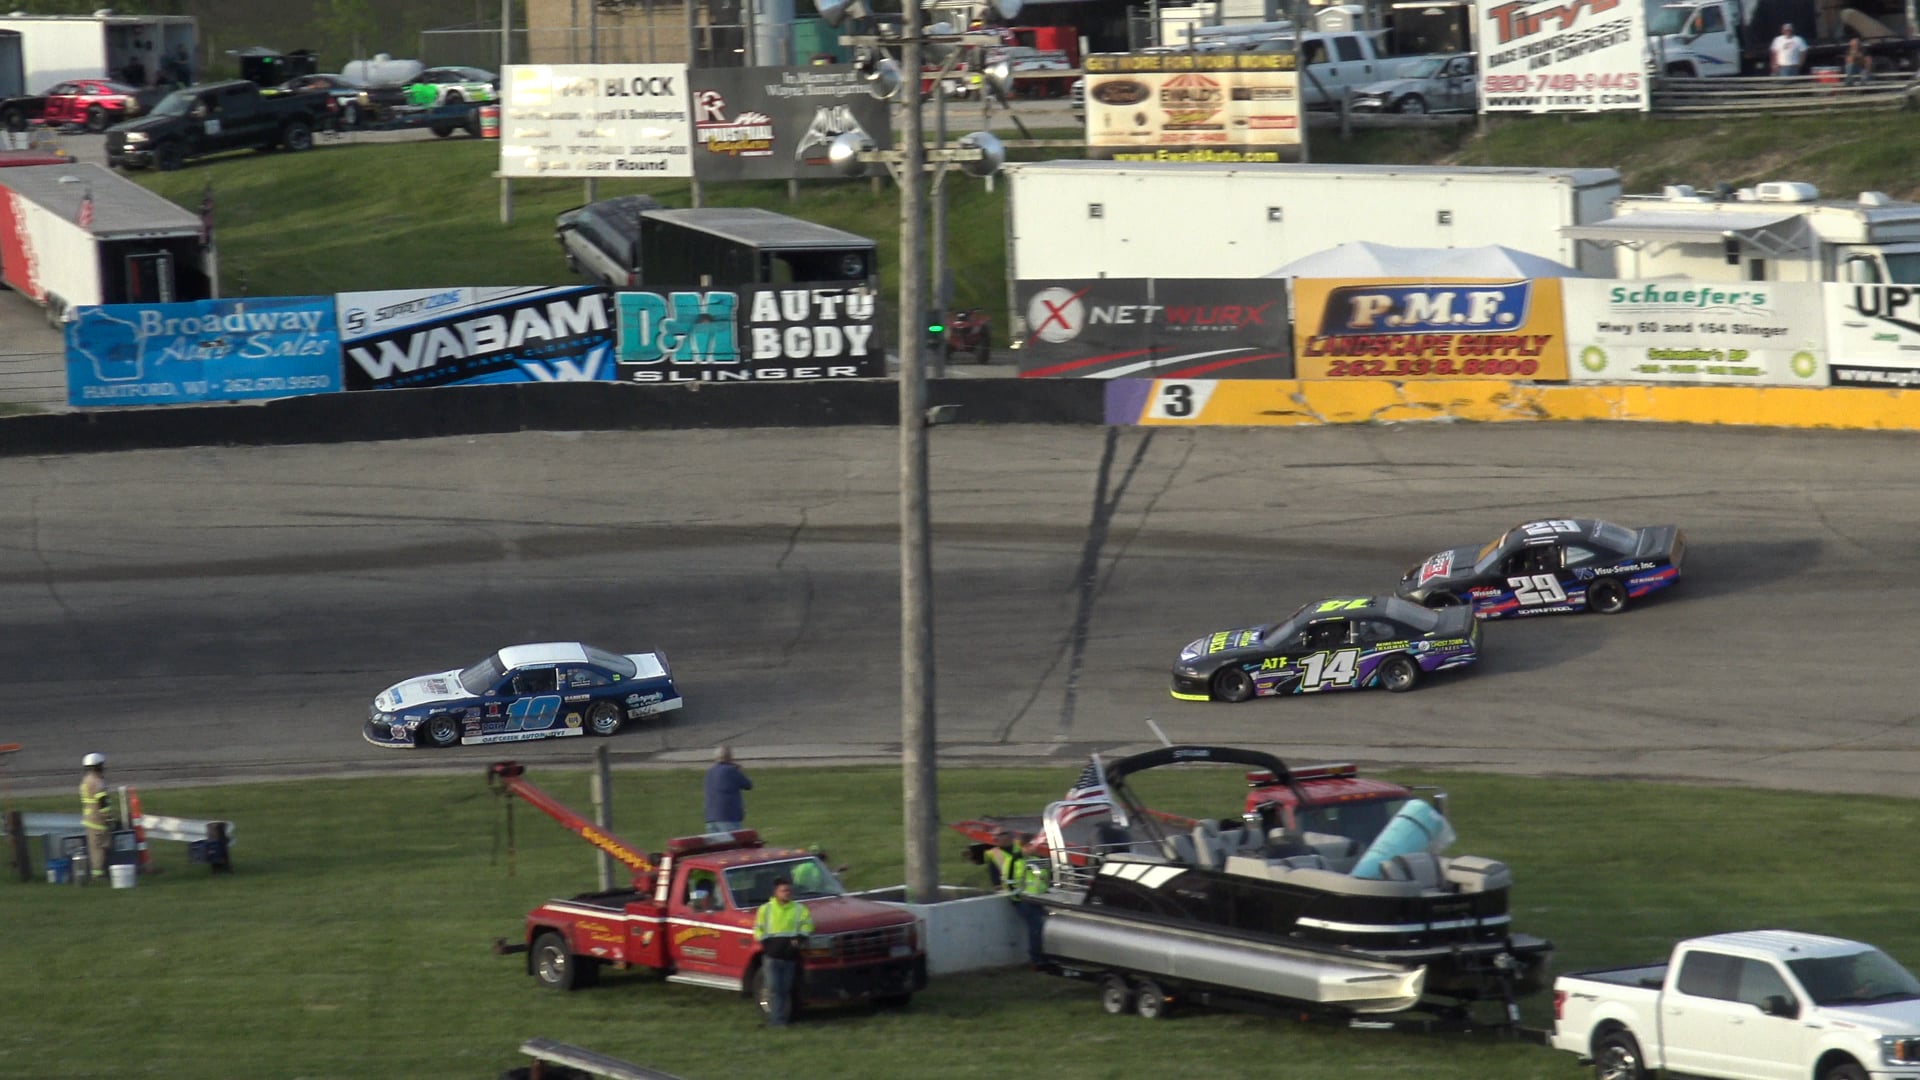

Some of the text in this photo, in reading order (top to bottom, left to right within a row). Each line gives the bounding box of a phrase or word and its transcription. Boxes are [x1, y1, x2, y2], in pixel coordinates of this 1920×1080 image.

[1556, 29, 1631, 62] COMPONENTS
[1086, 57, 1116, 70] GET
[1120, 56, 1160, 69] MORE
[1163, 56, 1193, 69] FOR
[1198, 55, 1235, 69] YOUR
[606, 76, 675, 97] BLOCK
[615, 158, 668, 171] Round
[751, 288, 875, 321] AUTO
[1610, 284, 1767, 307] Schaefer's
[139, 303, 323, 337] Broadway
[1089, 302, 1272, 327] NETWURX
[1347, 291, 1514, 329] P.M.F.
[348, 293, 608, 380] WABAM
[614, 291, 740, 365] D&M
[1597, 321, 1788, 338] Hwy 60 and 164 Slinger
[239, 332, 330, 358] Sales
[752, 325, 873, 360] BODY
[1303, 334, 1552, 357] LANDSCAPE SUPPLY
[633, 366, 858, 382] SLINGER
[1165, 384, 1193, 417] 3
[1641, 561, 1656, 569] Inc.
[1506, 573, 1567, 605] 29
[1261, 657, 1288, 670] ATF
[1297, 648, 1360, 690] 14
[521, 731, 565, 739] AUTOMTIVE
